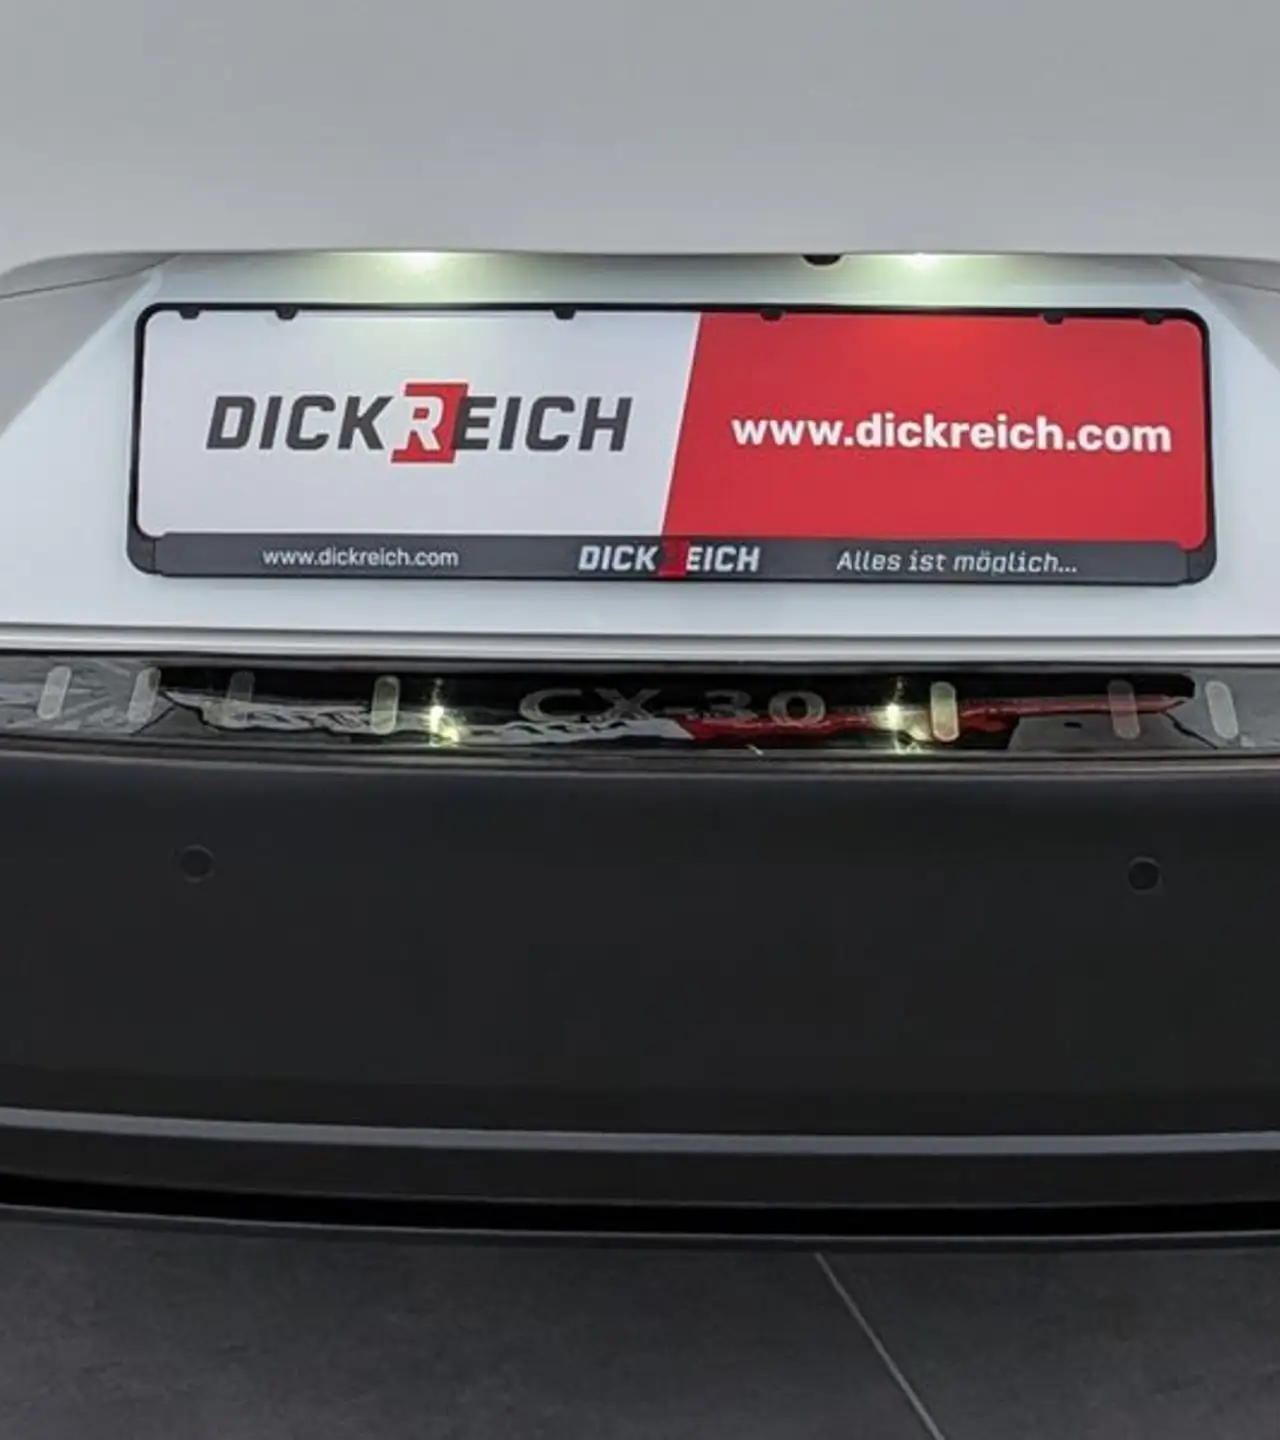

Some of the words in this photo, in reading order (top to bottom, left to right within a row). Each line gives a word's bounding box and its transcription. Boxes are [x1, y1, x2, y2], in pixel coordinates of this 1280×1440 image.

[205, 394, 633, 453] DICKREICH
[731, 412, 1173, 453] www.dickreich.com
[262, 546, 460, 569] www.dickreich.com
[577, 544, 762, 574] DICKEICH
[836, 549, 902, 572] Alles
[907, 550, 947, 572] ist
[952, 550, 1078, 576] möglich...
